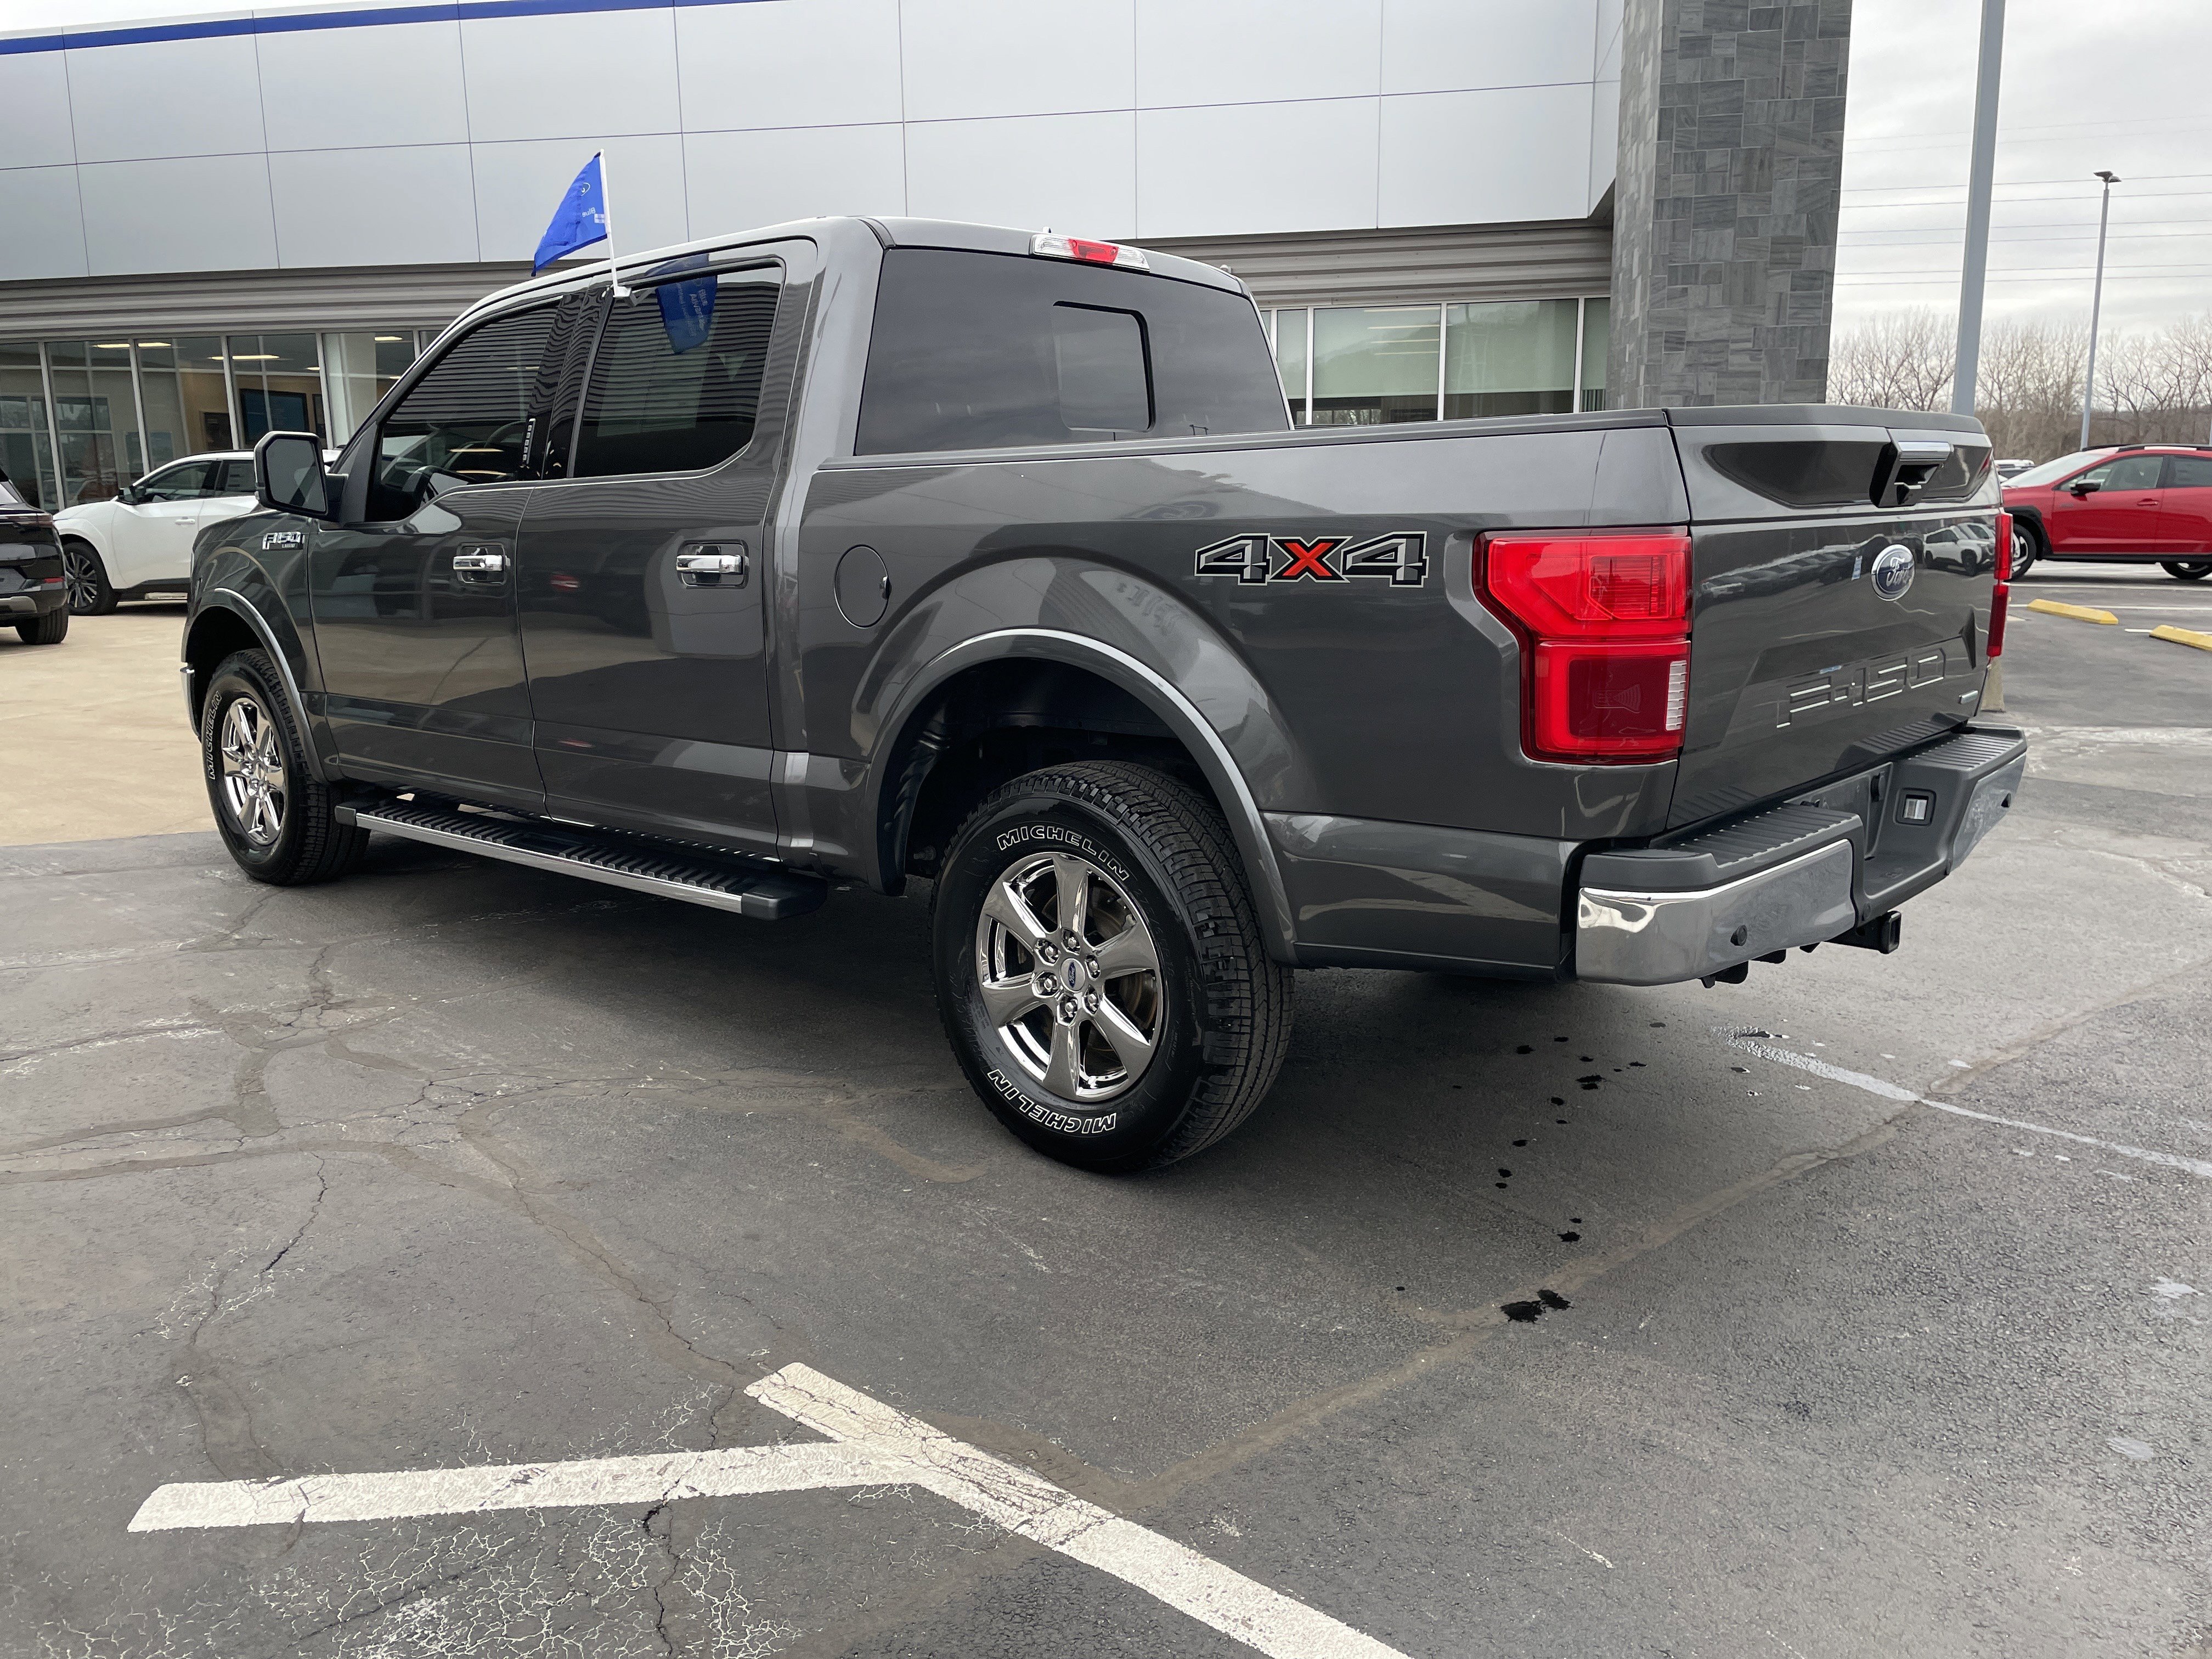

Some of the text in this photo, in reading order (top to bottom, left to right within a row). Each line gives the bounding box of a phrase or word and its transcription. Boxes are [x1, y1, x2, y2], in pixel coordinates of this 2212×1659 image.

[205, 690, 222, 780] MICHELIN
[996, 825, 1130, 881] MICHELIN
[988, 1069, 1117, 1135] MICHELIN
